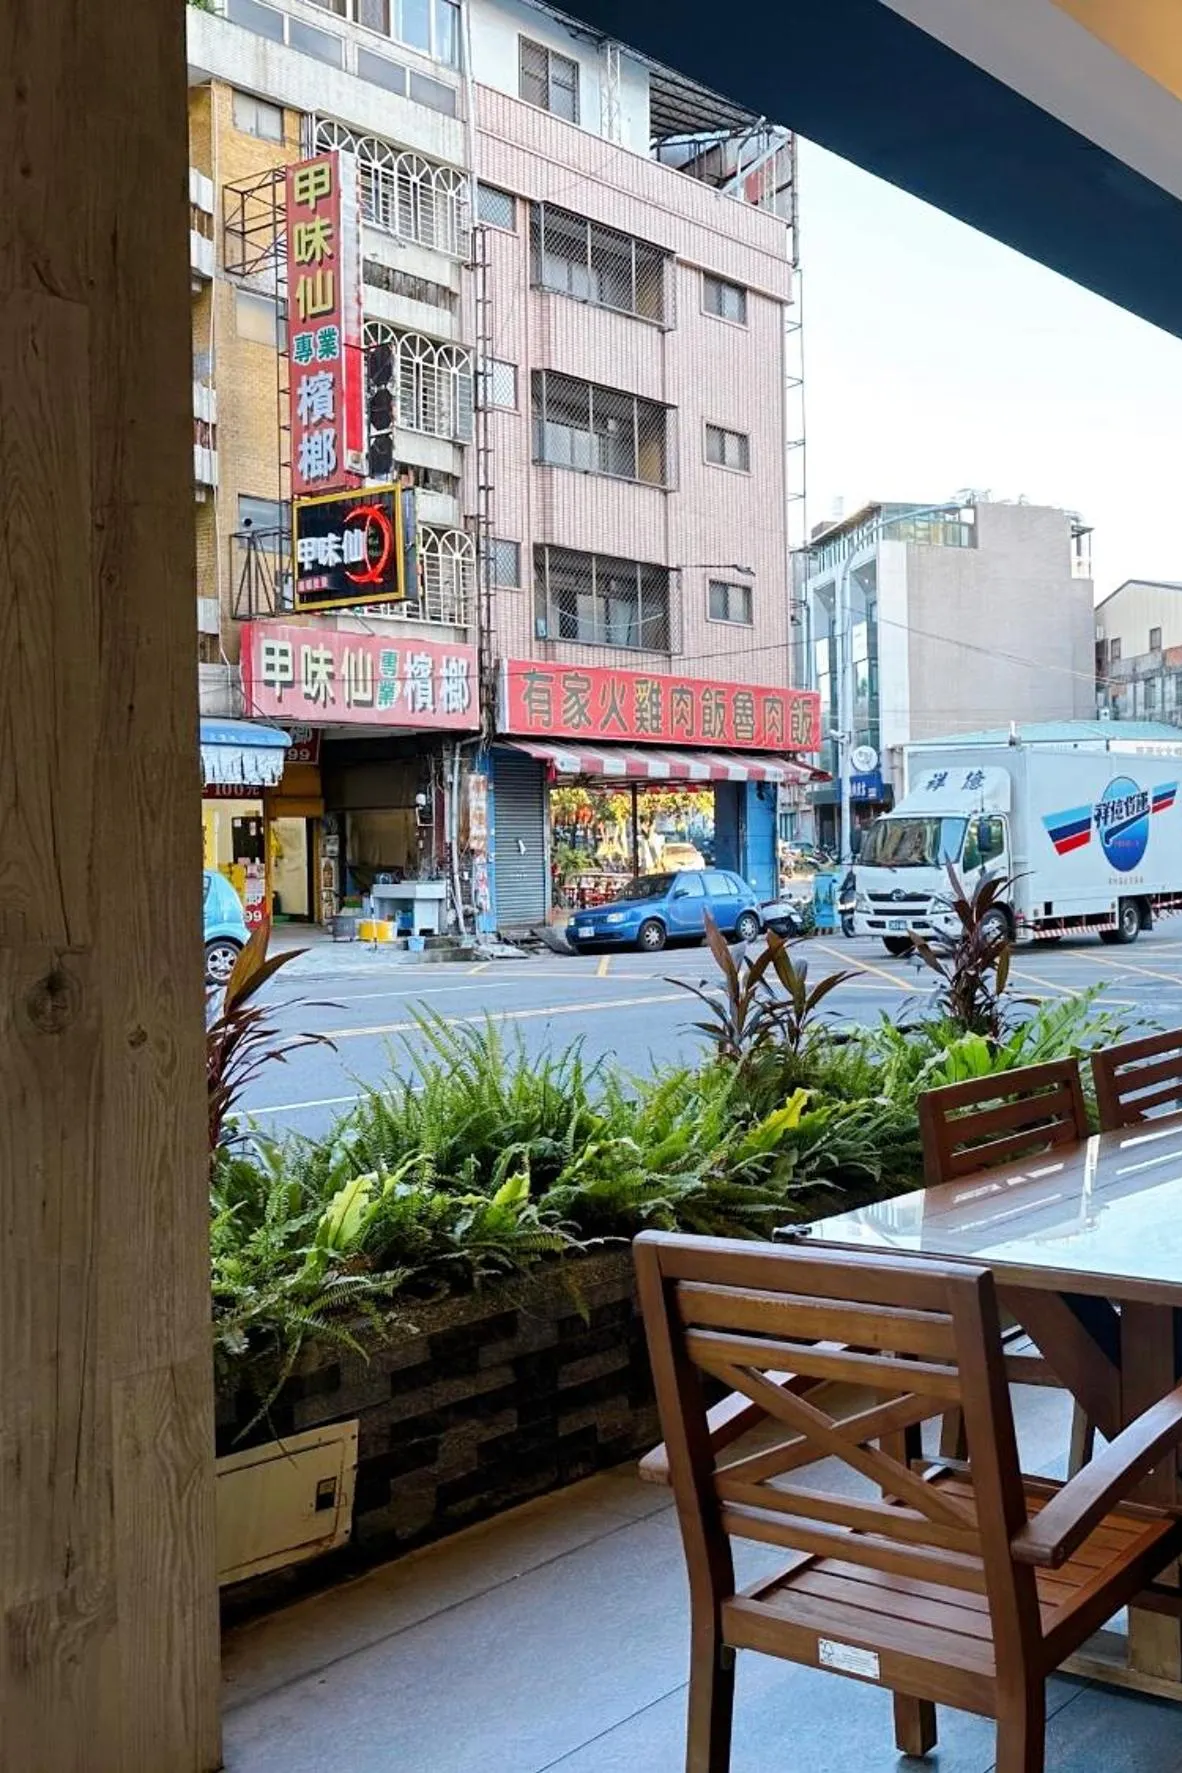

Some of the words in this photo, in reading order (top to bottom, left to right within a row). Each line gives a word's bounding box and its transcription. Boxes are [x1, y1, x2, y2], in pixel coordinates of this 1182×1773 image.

[293, 161, 335, 322] 甲味仙
[293, 326, 339, 364] 專業
[296, 371, 337, 480] 檳榔
[297, 529, 366, 571] 甲味仙
[261, 639, 374, 708] 甲味仙
[376, 649, 400, 711] 專業
[403, 650, 472, 714] 檳榔
[521, 668, 813, 745] 有家火雞肉飯魯肉飯
